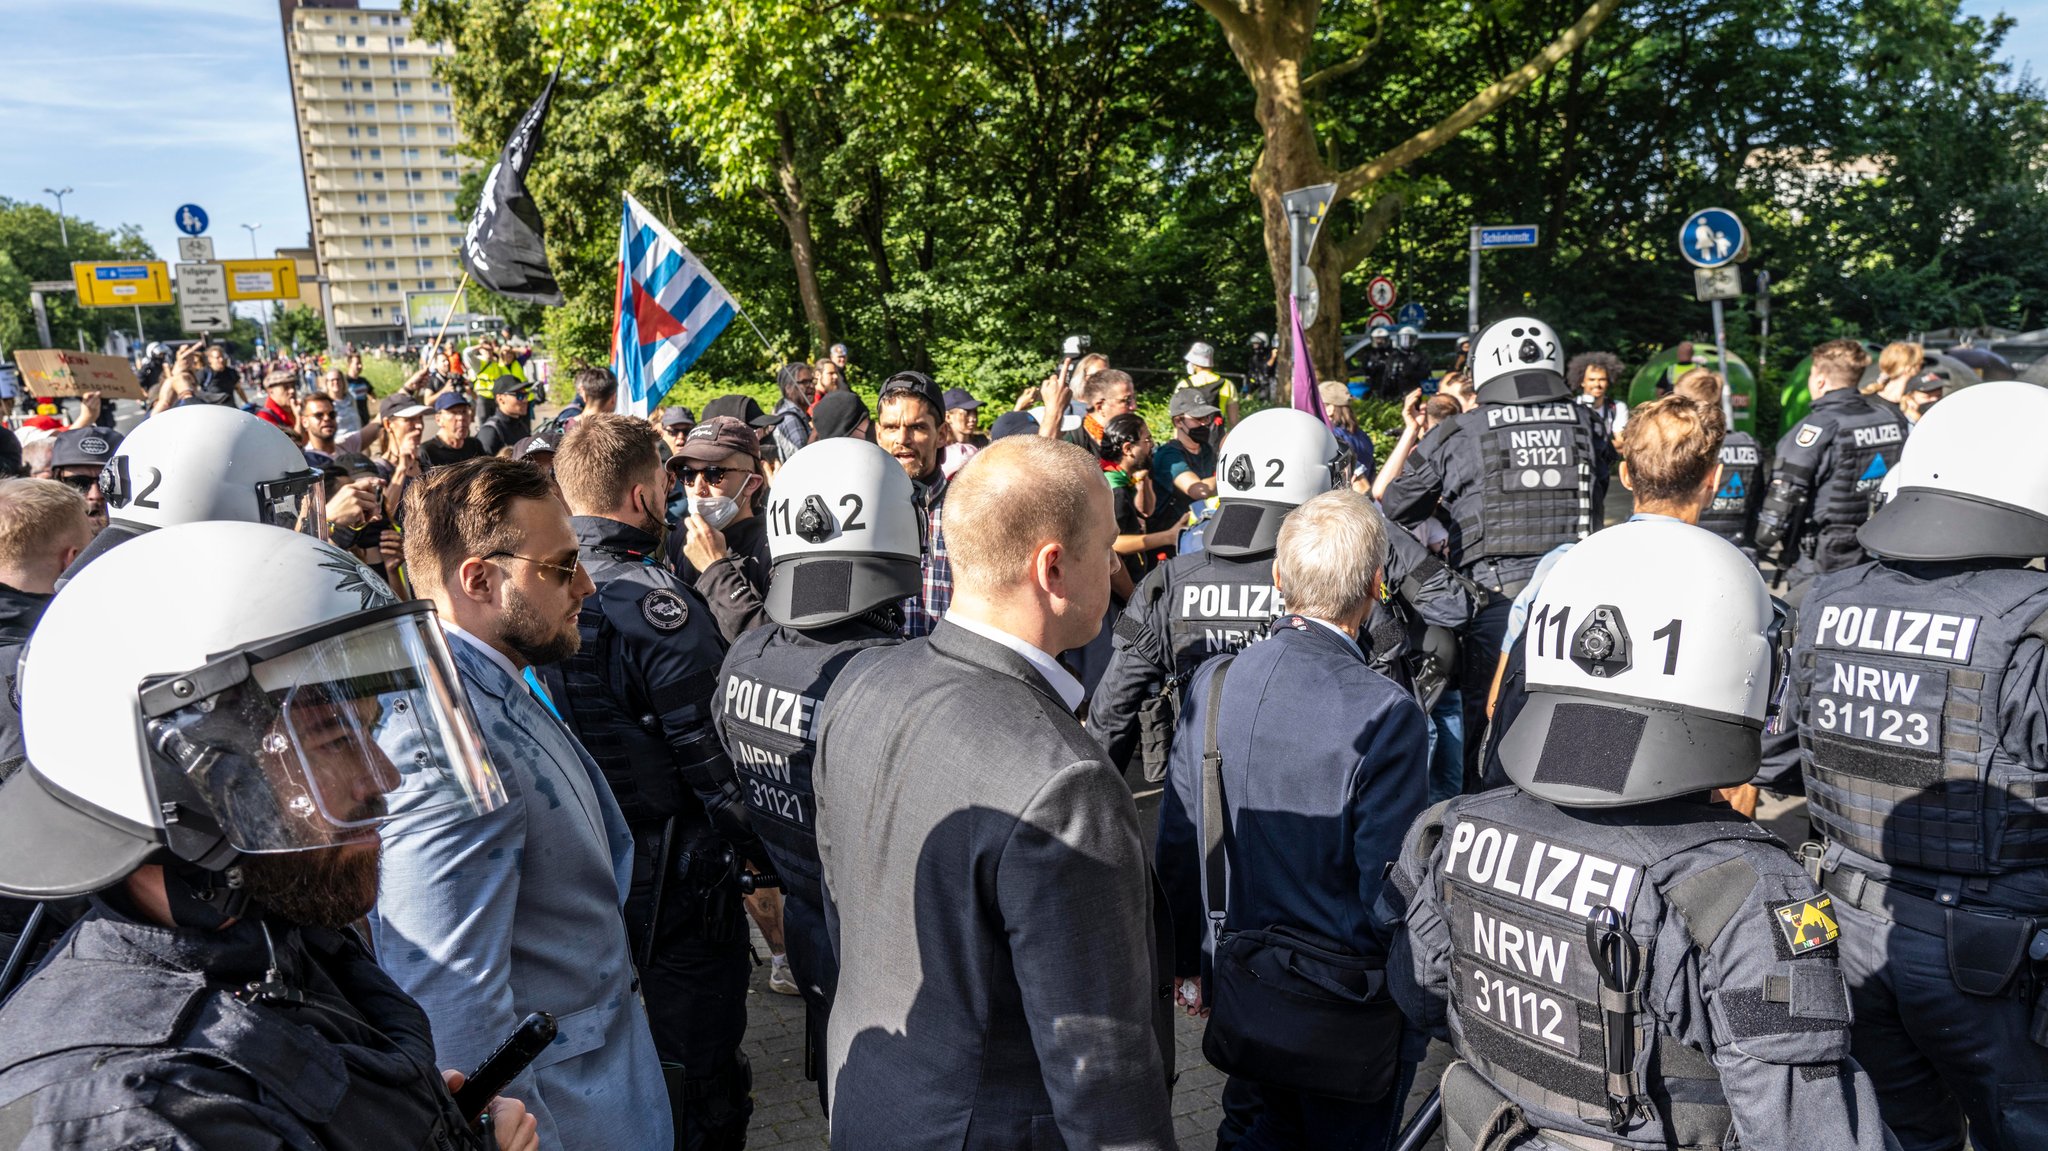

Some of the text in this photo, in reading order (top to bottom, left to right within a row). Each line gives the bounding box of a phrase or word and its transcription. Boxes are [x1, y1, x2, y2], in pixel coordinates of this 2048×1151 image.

[1492, 341, 1556, 366] 11 2
[1487, 403, 1577, 428] POLIZEI
[1853, 423, 1903, 447] POLIZEI
[1511, 429, 1562, 448] NRW
[1516, 447, 1567, 466] 31121
[133, 466, 162, 509] 2
[1264, 458, 1285, 488] 2
[769, 493, 866, 537] 11 2
[1182, 584, 1287, 618] POLIZE
[1534, 603, 1683, 676] 11 1
[1815, 605, 1977, 661] POLIZEI
[1832, 662, 1920, 706] NRW
[724, 675, 824, 742] POLIZEI
[1817, 697, 1929, 746] 31123
[738, 741, 791, 785] NRW
[749, 778, 804, 823] 31121
[1444, 821, 1636, 926] POLIZEI
[1473, 911, 1570, 985] NRW
[1473, 970, 1566, 1046] 31112
